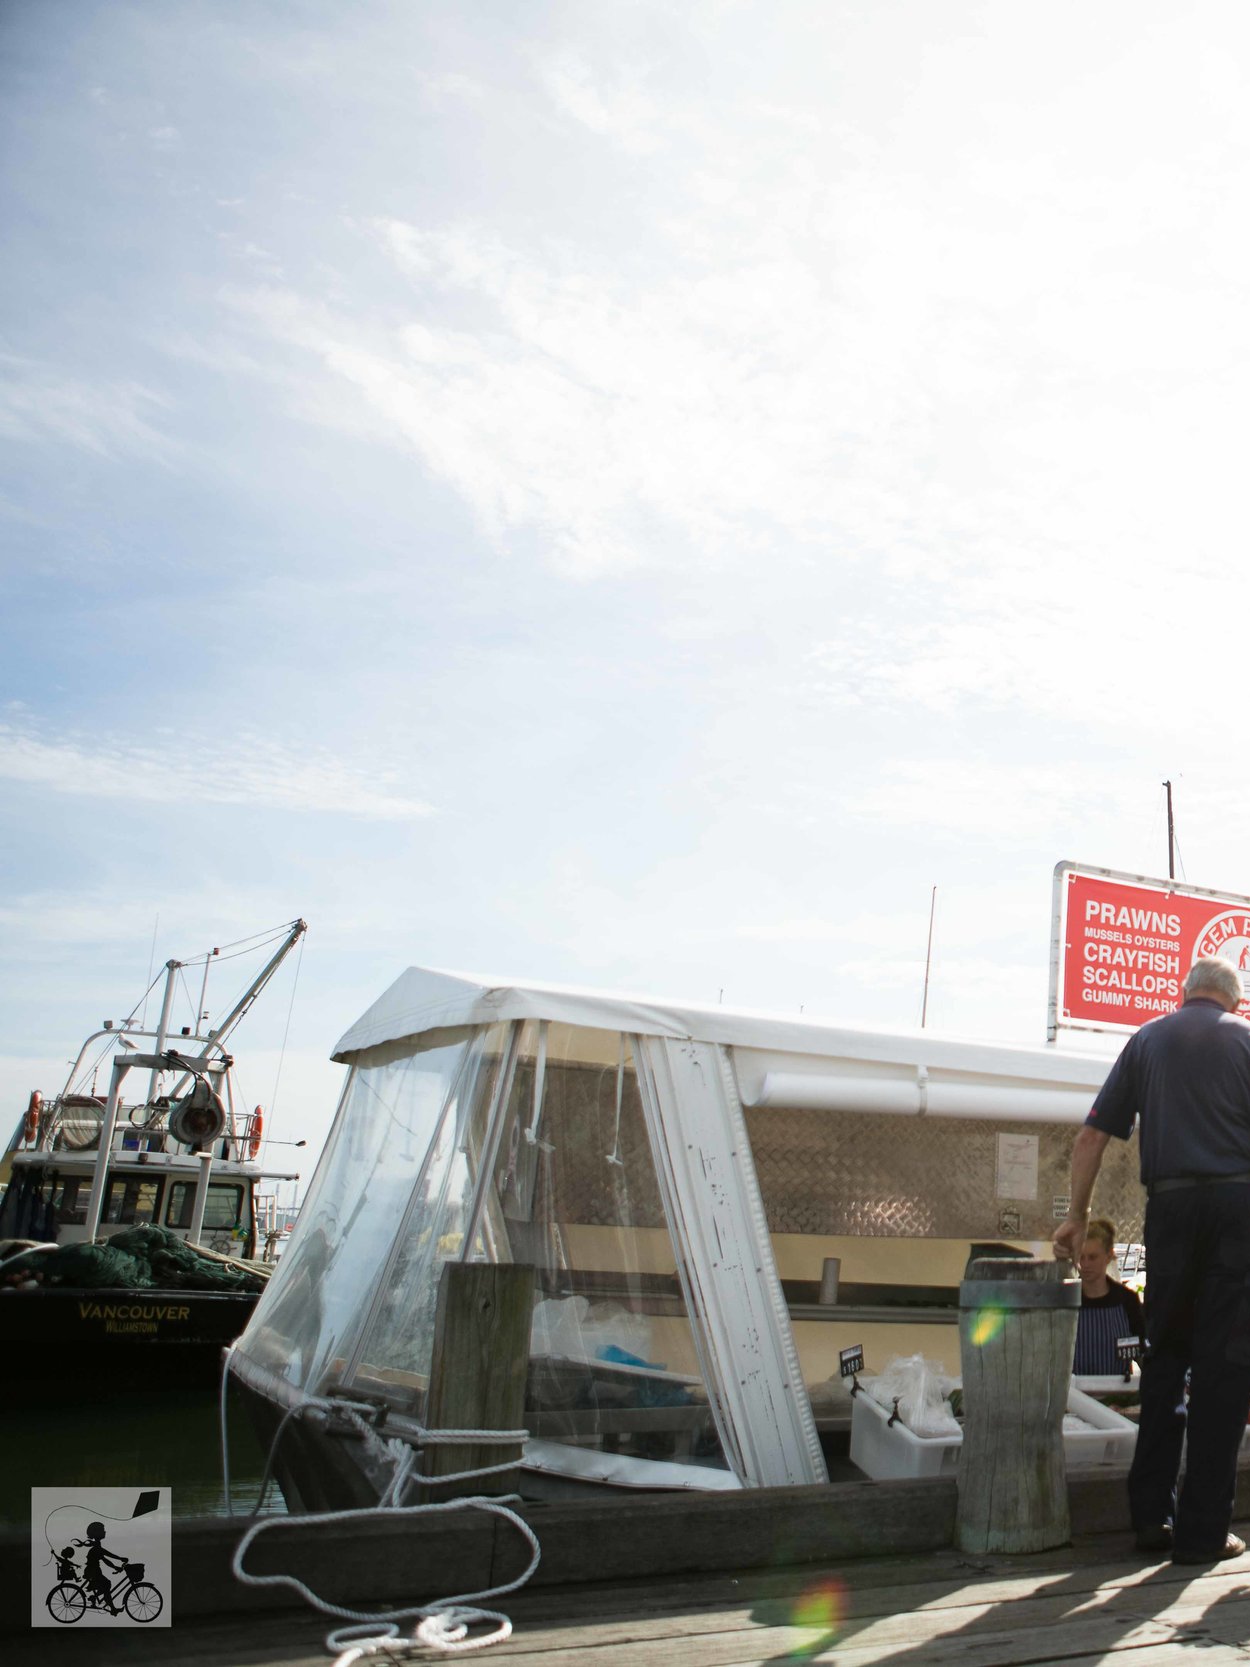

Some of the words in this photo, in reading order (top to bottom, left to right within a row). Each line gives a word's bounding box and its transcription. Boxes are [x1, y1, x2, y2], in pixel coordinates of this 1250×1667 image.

[1085, 900, 1181, 936] PRAWNS
[1084, 926, 1132, 945] MUSSELS
[1134, 935, 1180, 952] OYSTERS
[1200, 917, 1238, 957] GEM
[1084, 942, 1180, 975] CRAYFISH
[1082, 966, 1179, 996] SCALLOPS
[1082, 988, 1131, 1007] GUMMY
[1134, 996, 1178, 1013] SHARK
[78, 1302, 190, 1320] VANCOUVER
